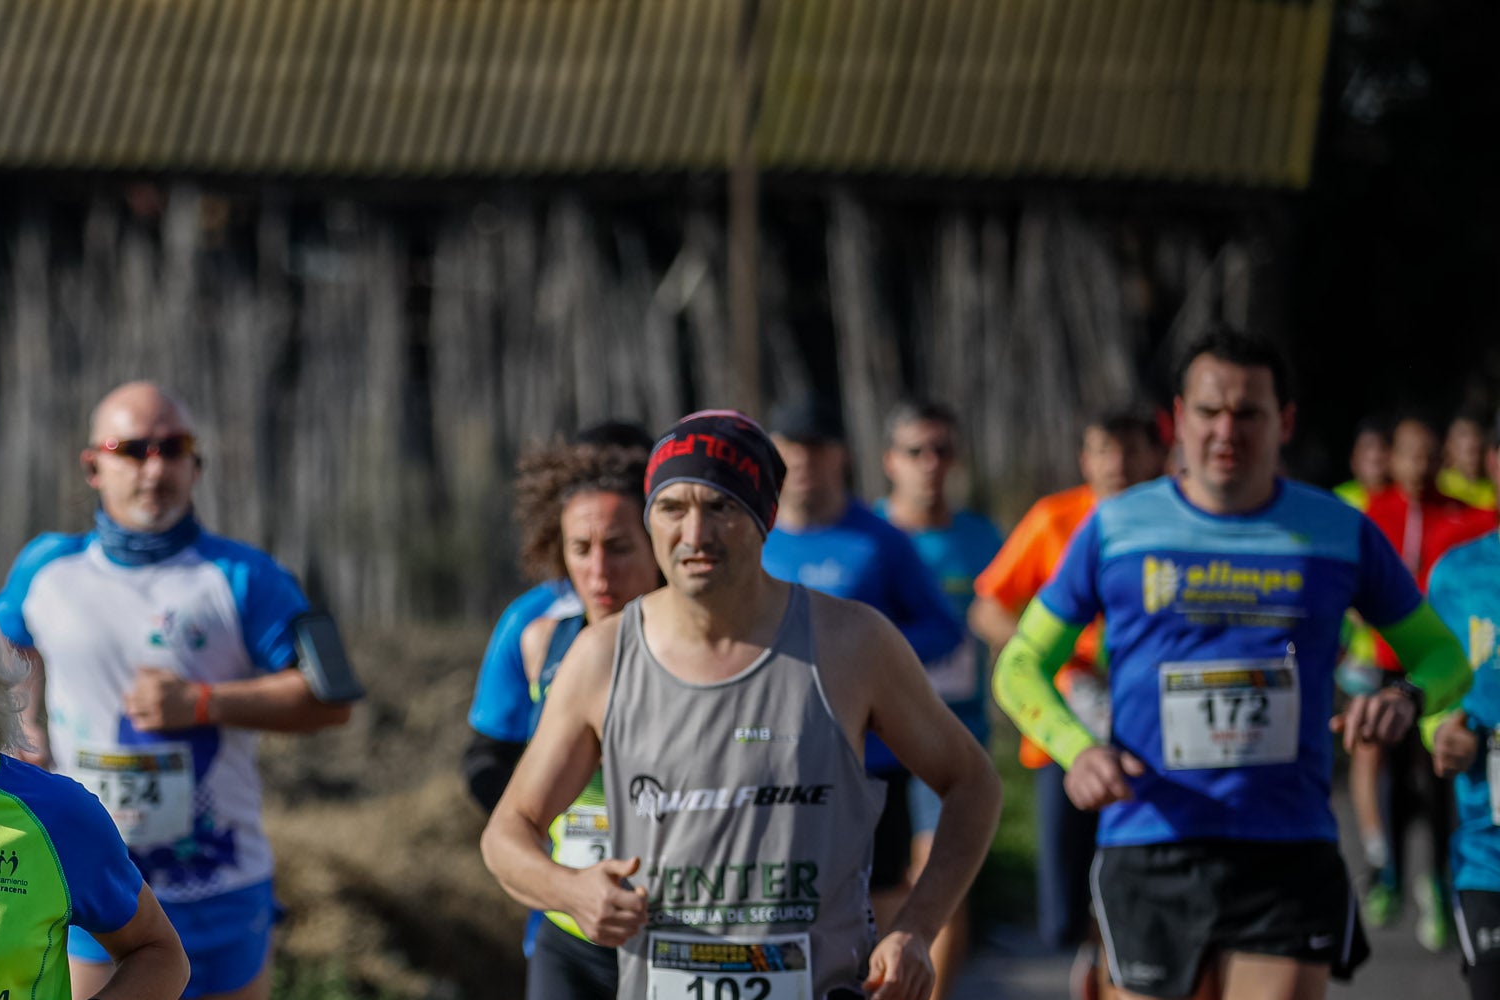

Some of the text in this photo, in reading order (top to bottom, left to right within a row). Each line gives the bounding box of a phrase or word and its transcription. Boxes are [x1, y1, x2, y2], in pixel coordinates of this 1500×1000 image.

[1199, 691, 1271, 727] 172
[657, 785, 833, 812] WOLFBIKE
[727, 909, 746, 922] DE
[749, 905, 815, 923] SEGUROS
